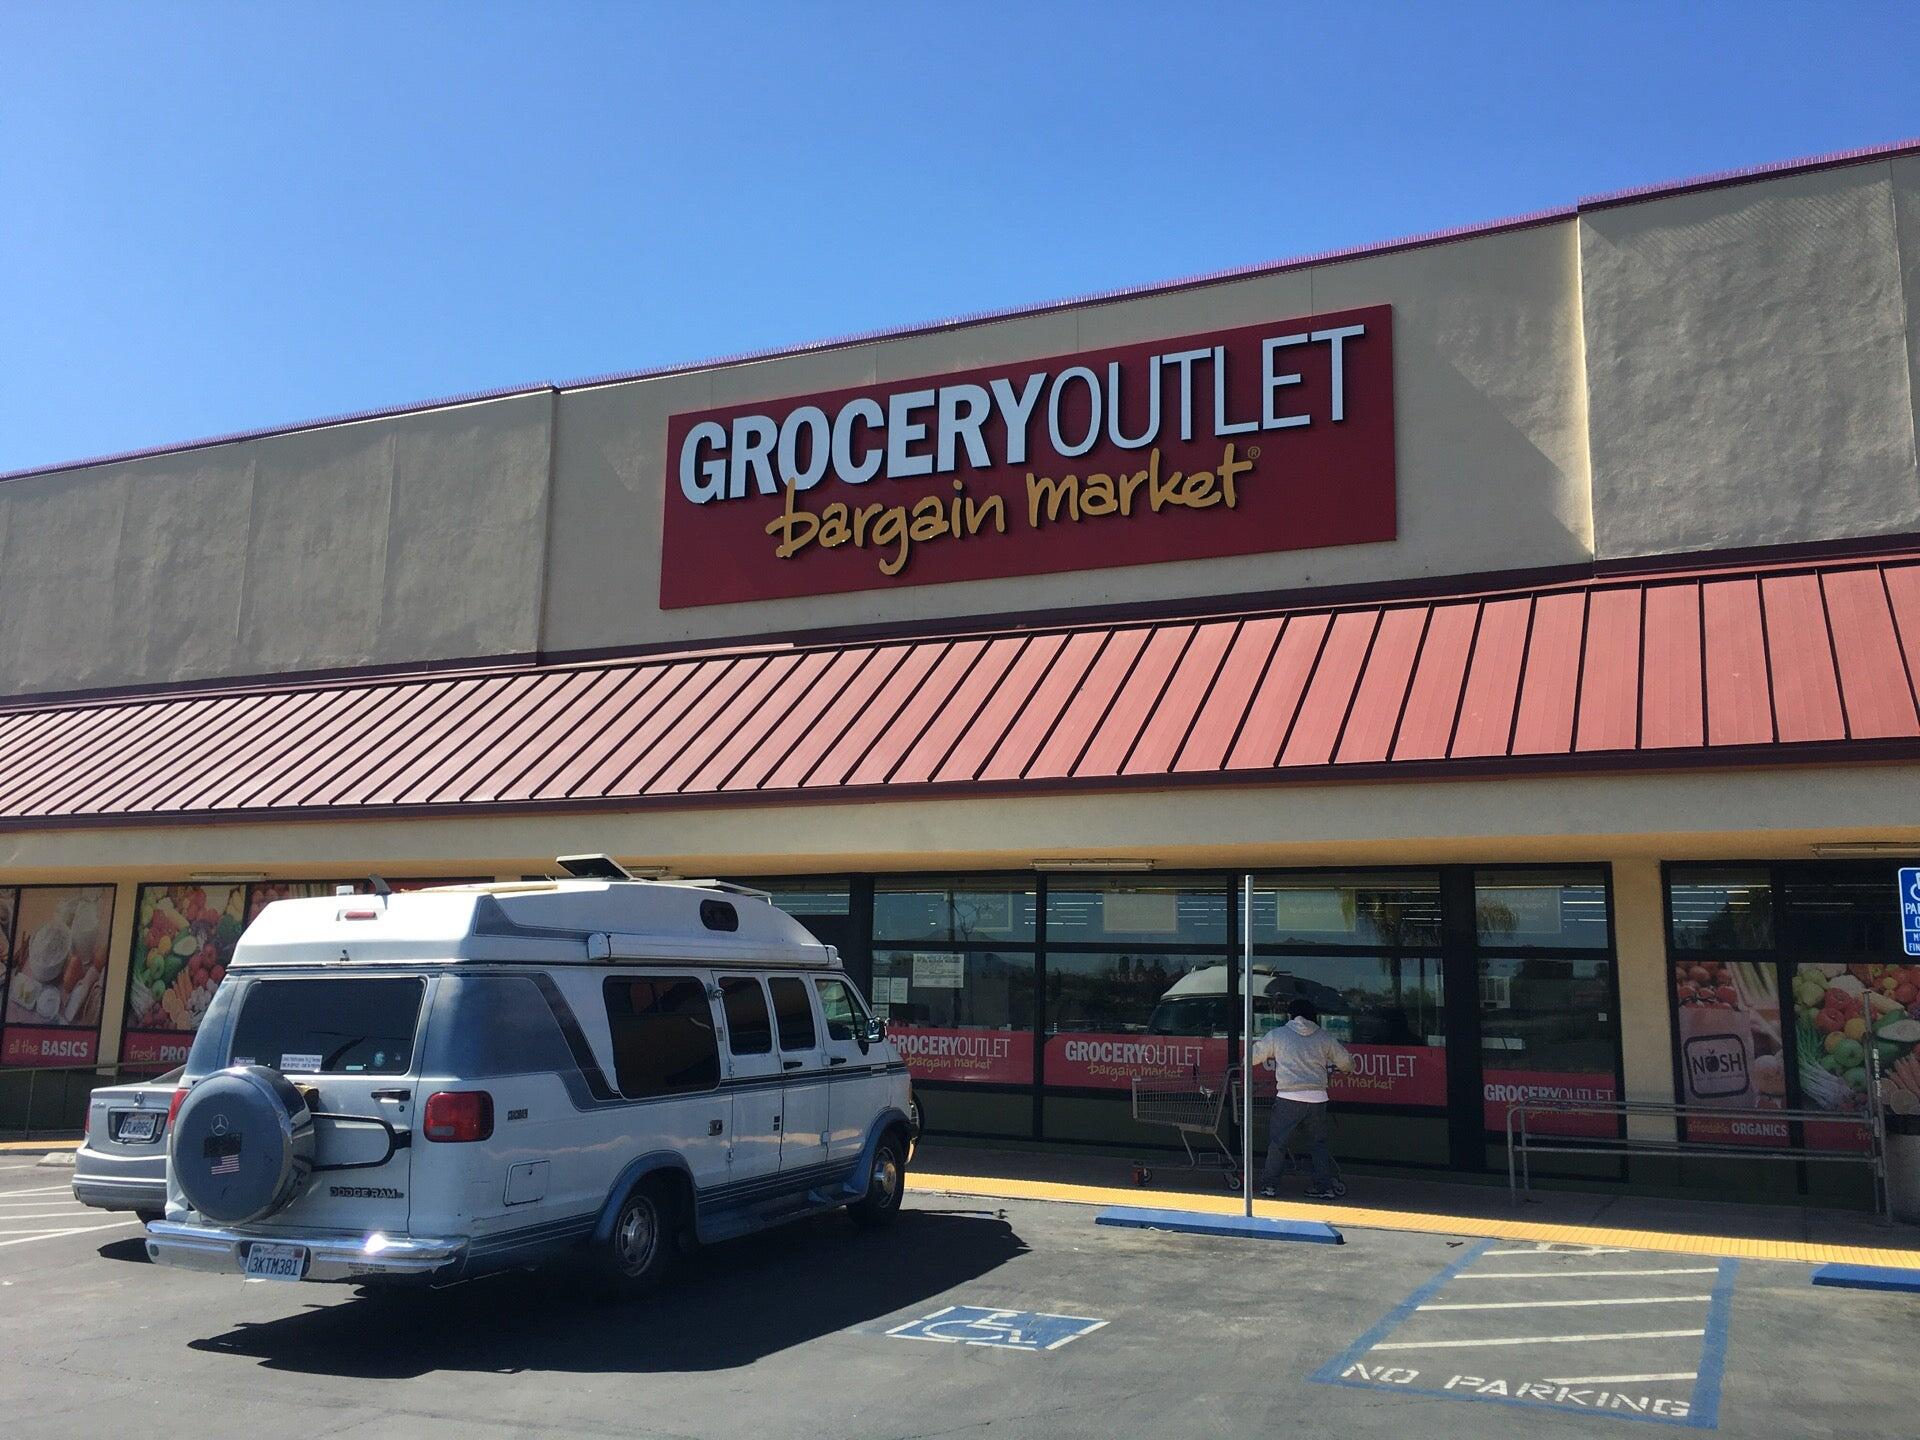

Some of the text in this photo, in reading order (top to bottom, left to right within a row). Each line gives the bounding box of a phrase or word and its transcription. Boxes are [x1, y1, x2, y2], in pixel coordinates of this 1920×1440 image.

[765, 442, 1253, 575] bargain market
[21, 1039, 38, 1056] the
[41, 1040, 88, 1058] BASICS
[130, 1044, 156, 1061] fresh
[906, 1054, 993, 1073] bargain market
[1087, 1060, 1138, 1081] bargain
[1348, 1076, 1395, 1090] market
[1732, 1122, 1788, 1137] ORGANICS
[330, 1186, 370, 1198] DODGE
[371, 1187, 397, 1199] RAM
[248, 1256, 299, 1276] 3KTM381
[1341, 1363, 1691, 1417] NO PARKING
